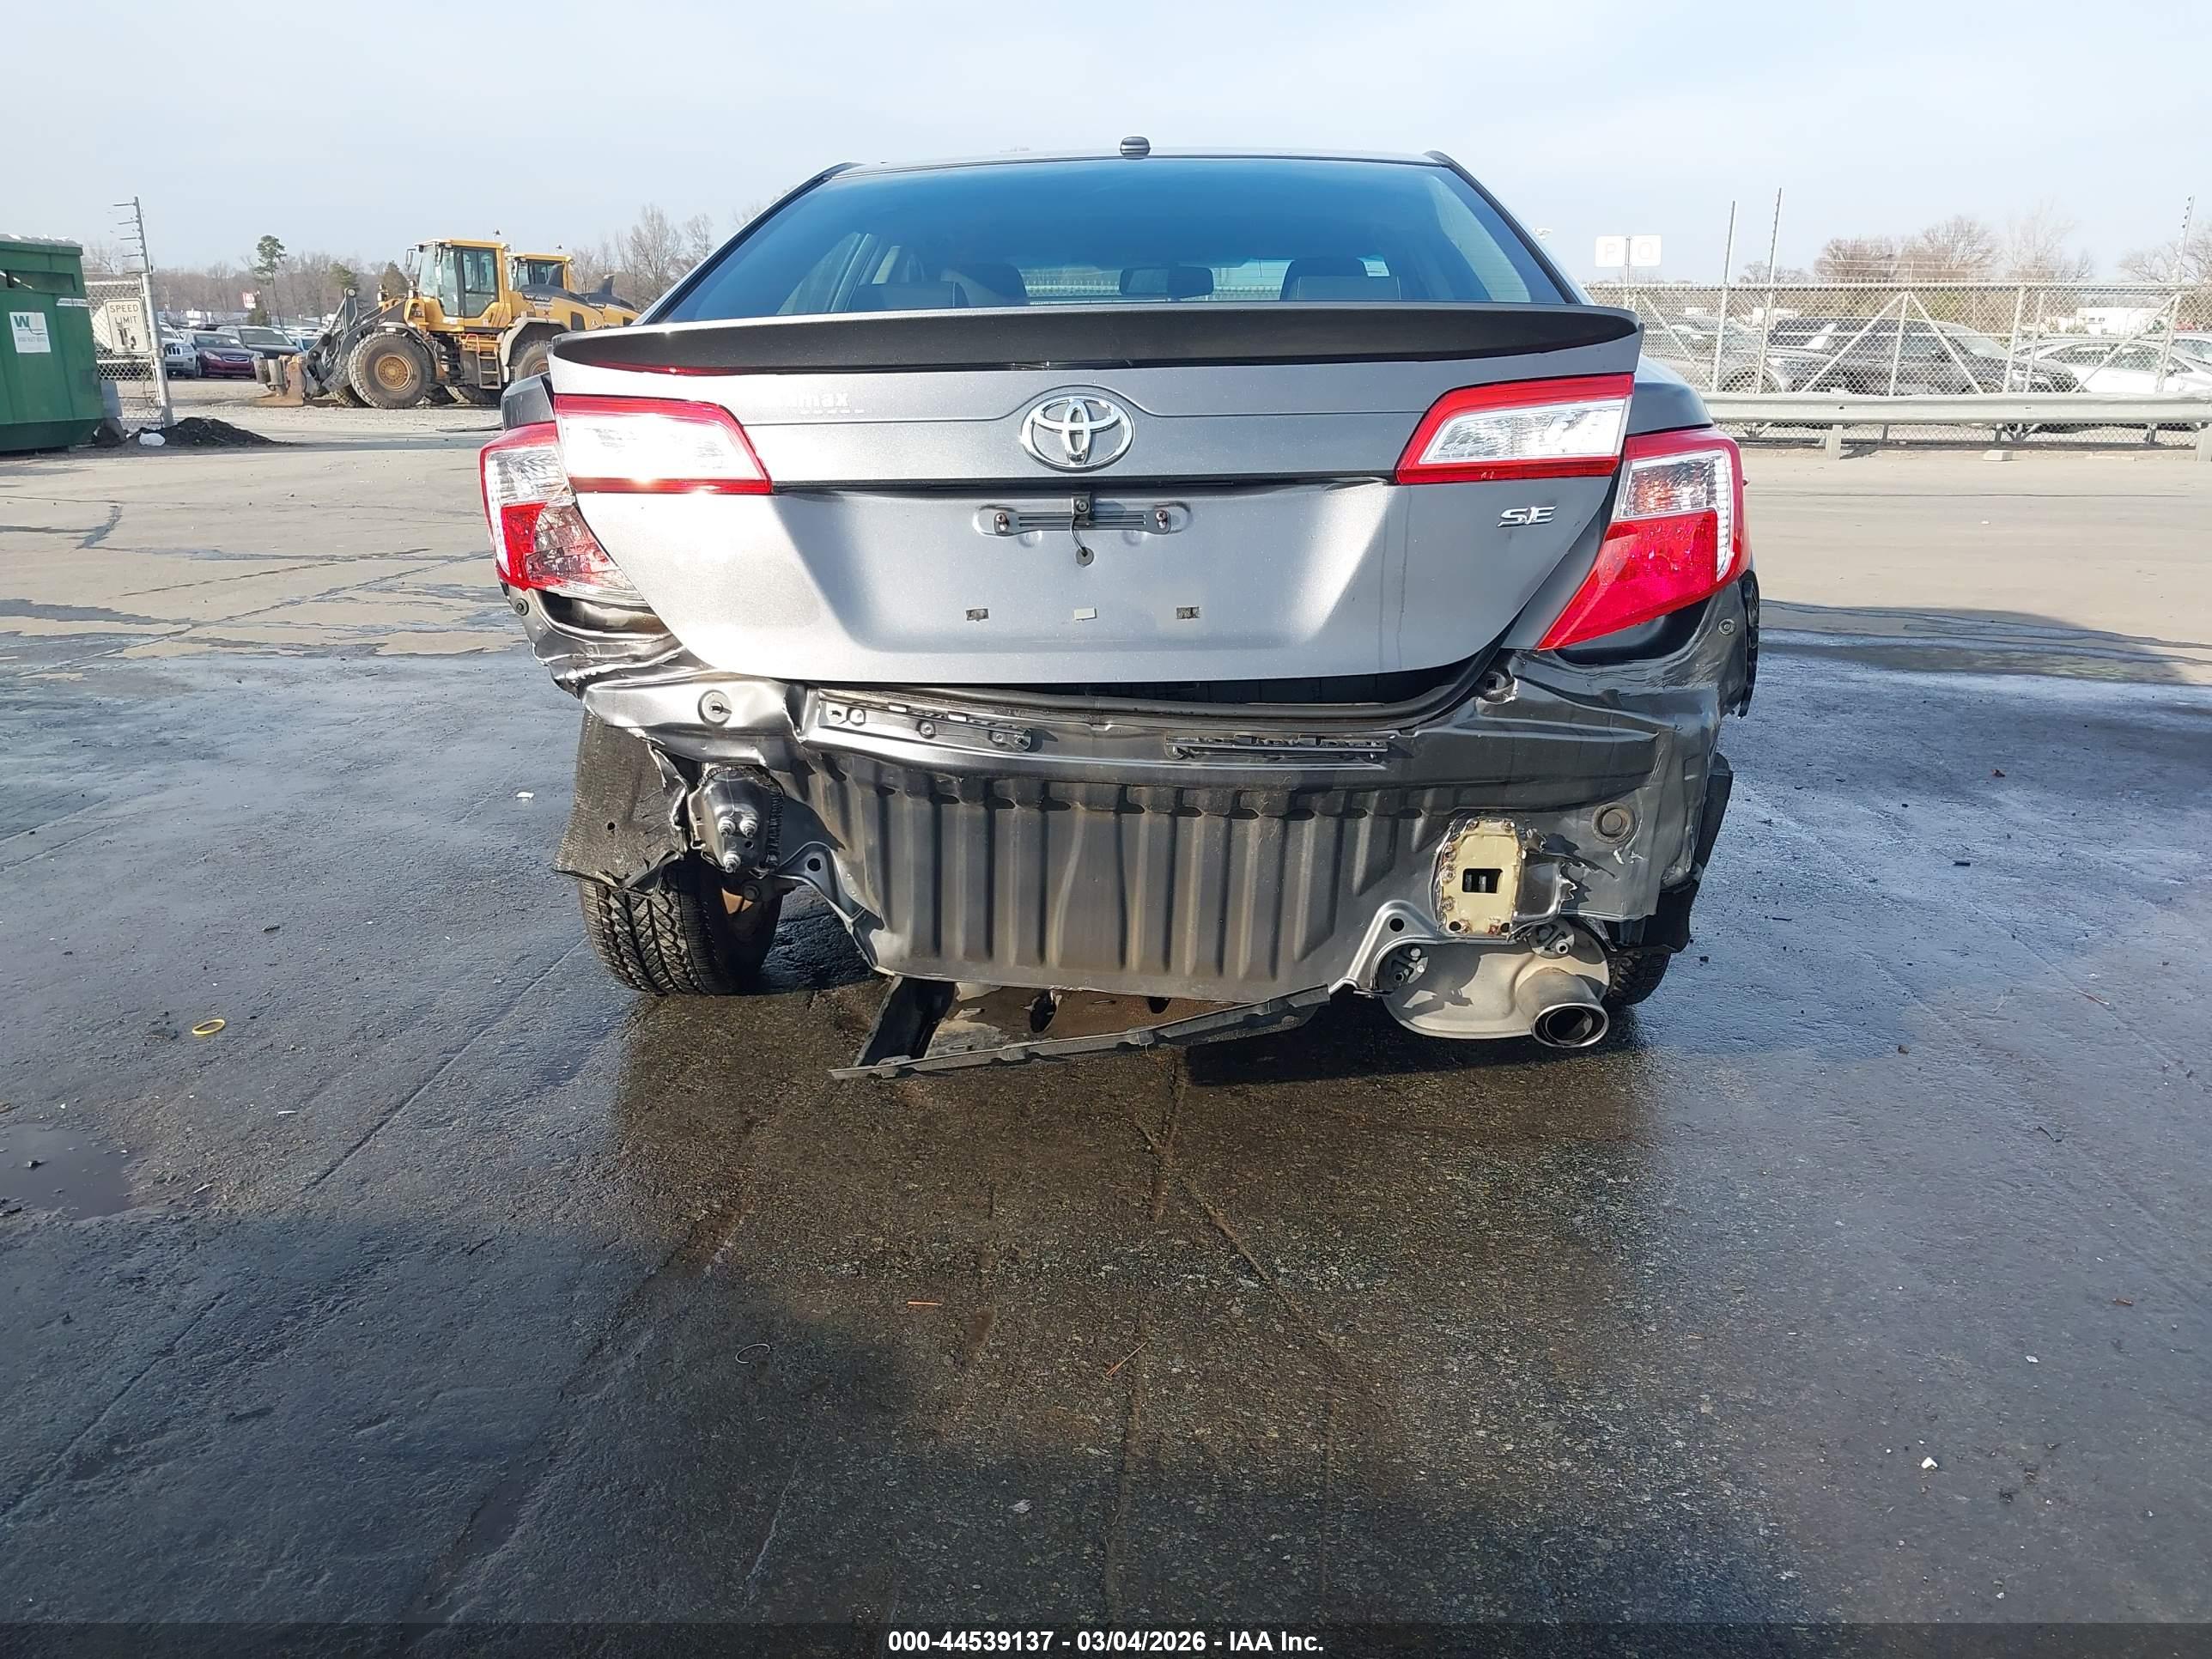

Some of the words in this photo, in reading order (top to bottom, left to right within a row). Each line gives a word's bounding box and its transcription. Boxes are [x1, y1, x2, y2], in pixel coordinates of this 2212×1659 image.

[109, 304, 139, 313] SPEED
[114, 315, 137, 325] LIMIT
[1497, 505, 1558, 527] SE
